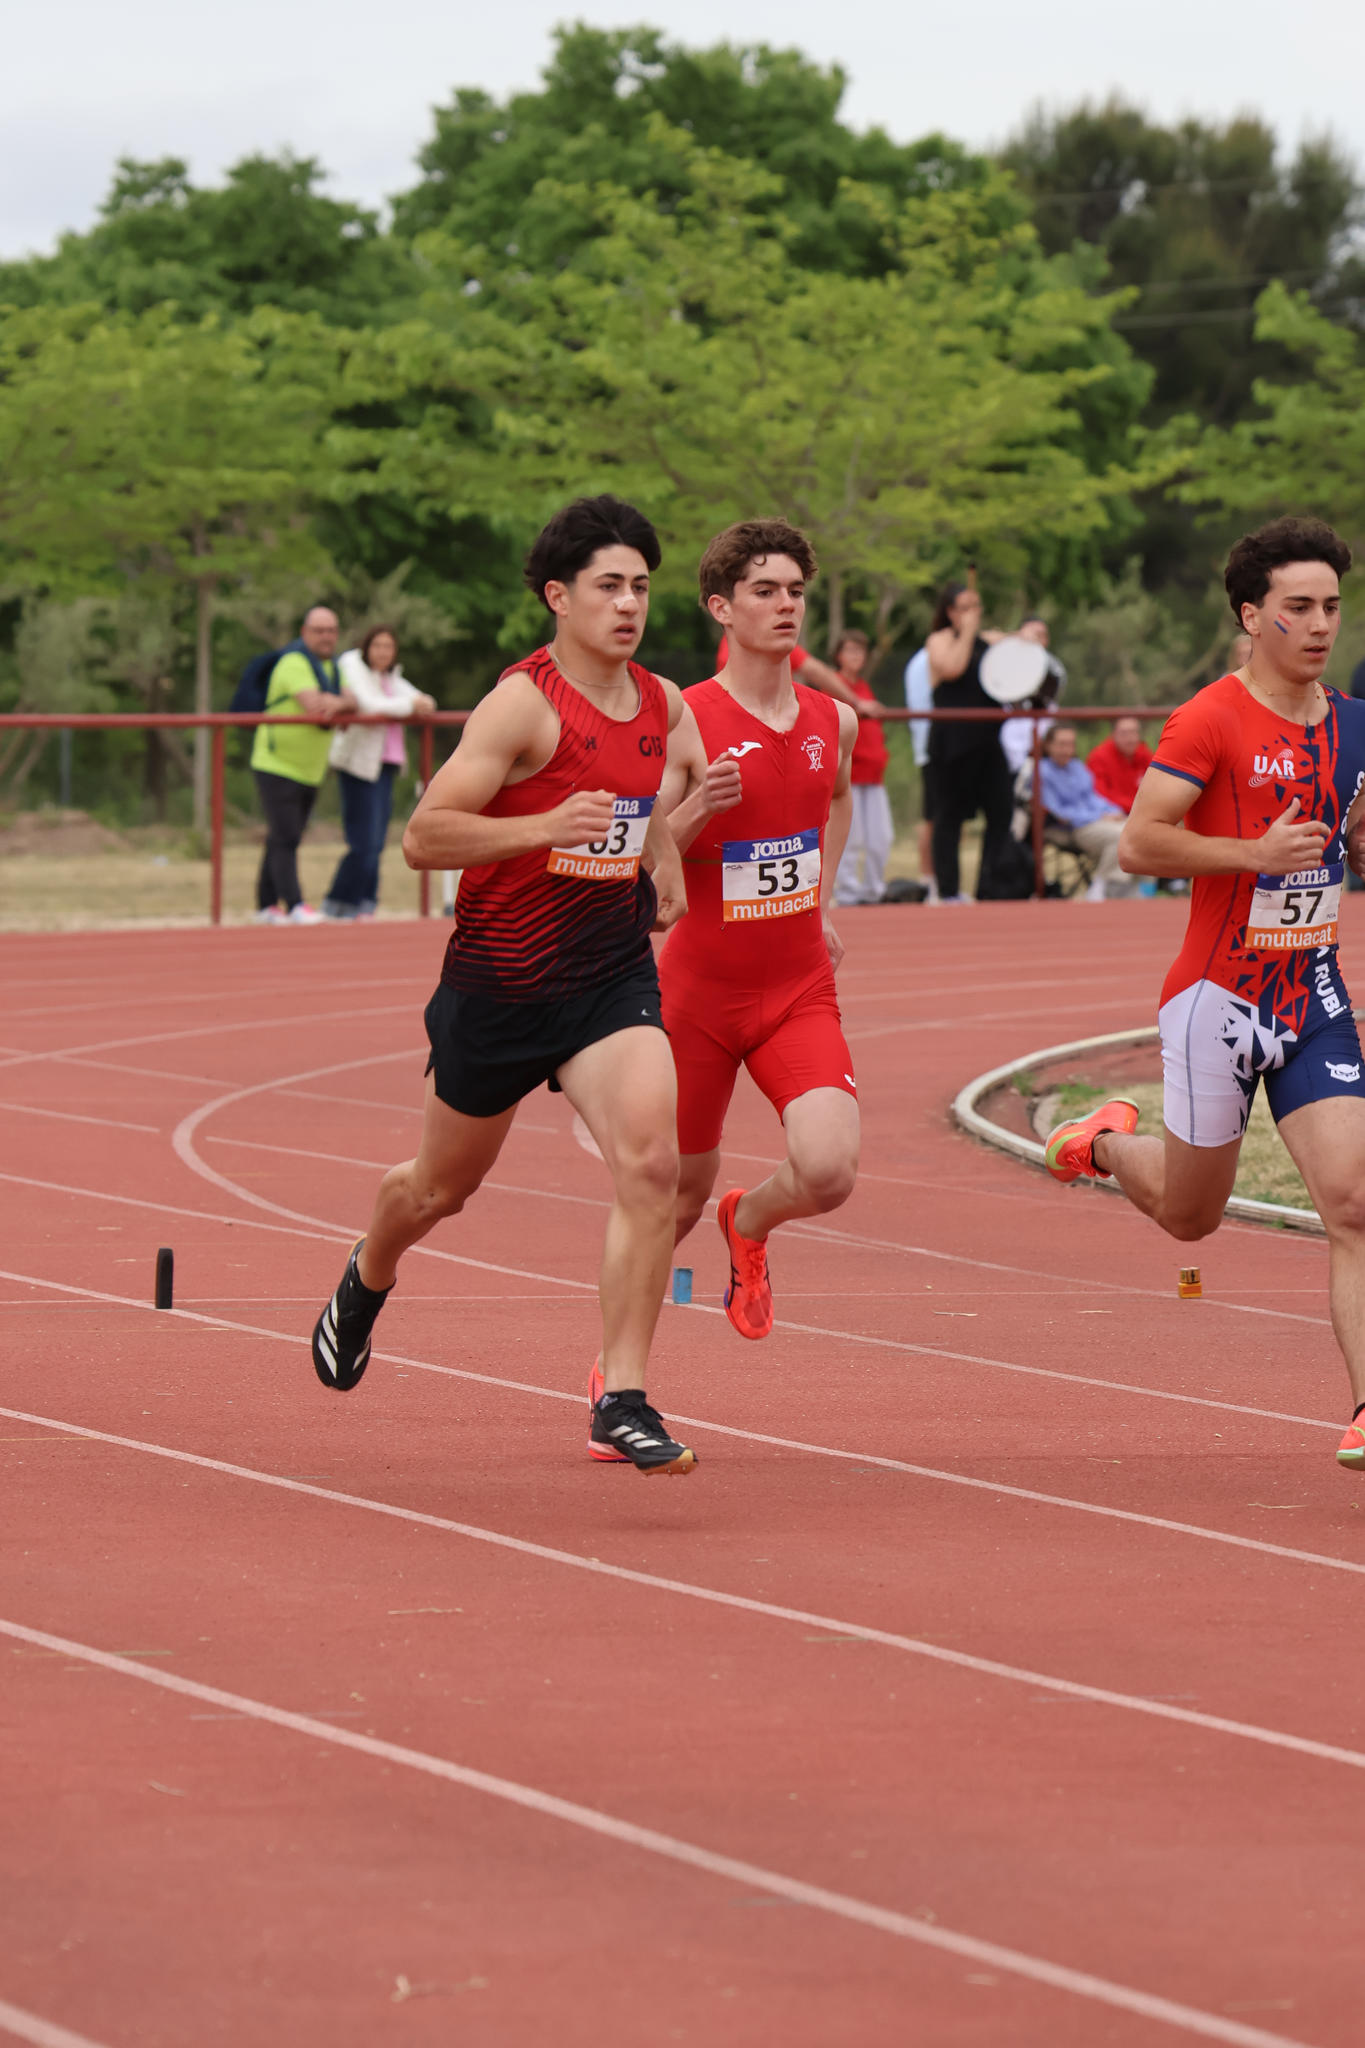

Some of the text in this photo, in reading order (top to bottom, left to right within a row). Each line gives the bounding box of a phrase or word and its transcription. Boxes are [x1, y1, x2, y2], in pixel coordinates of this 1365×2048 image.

[1254, 755, 1296, 777] UAR
[613, 799, 640, 815] ma
[555, 857, 636, 878] mutuacat
[757, 858, 800, 896] 53
[732, 890, 815, 920] mutuacat
[1280, 890, 1324, 926] 57
[1253, 925, 1333, 947] mutuacat
